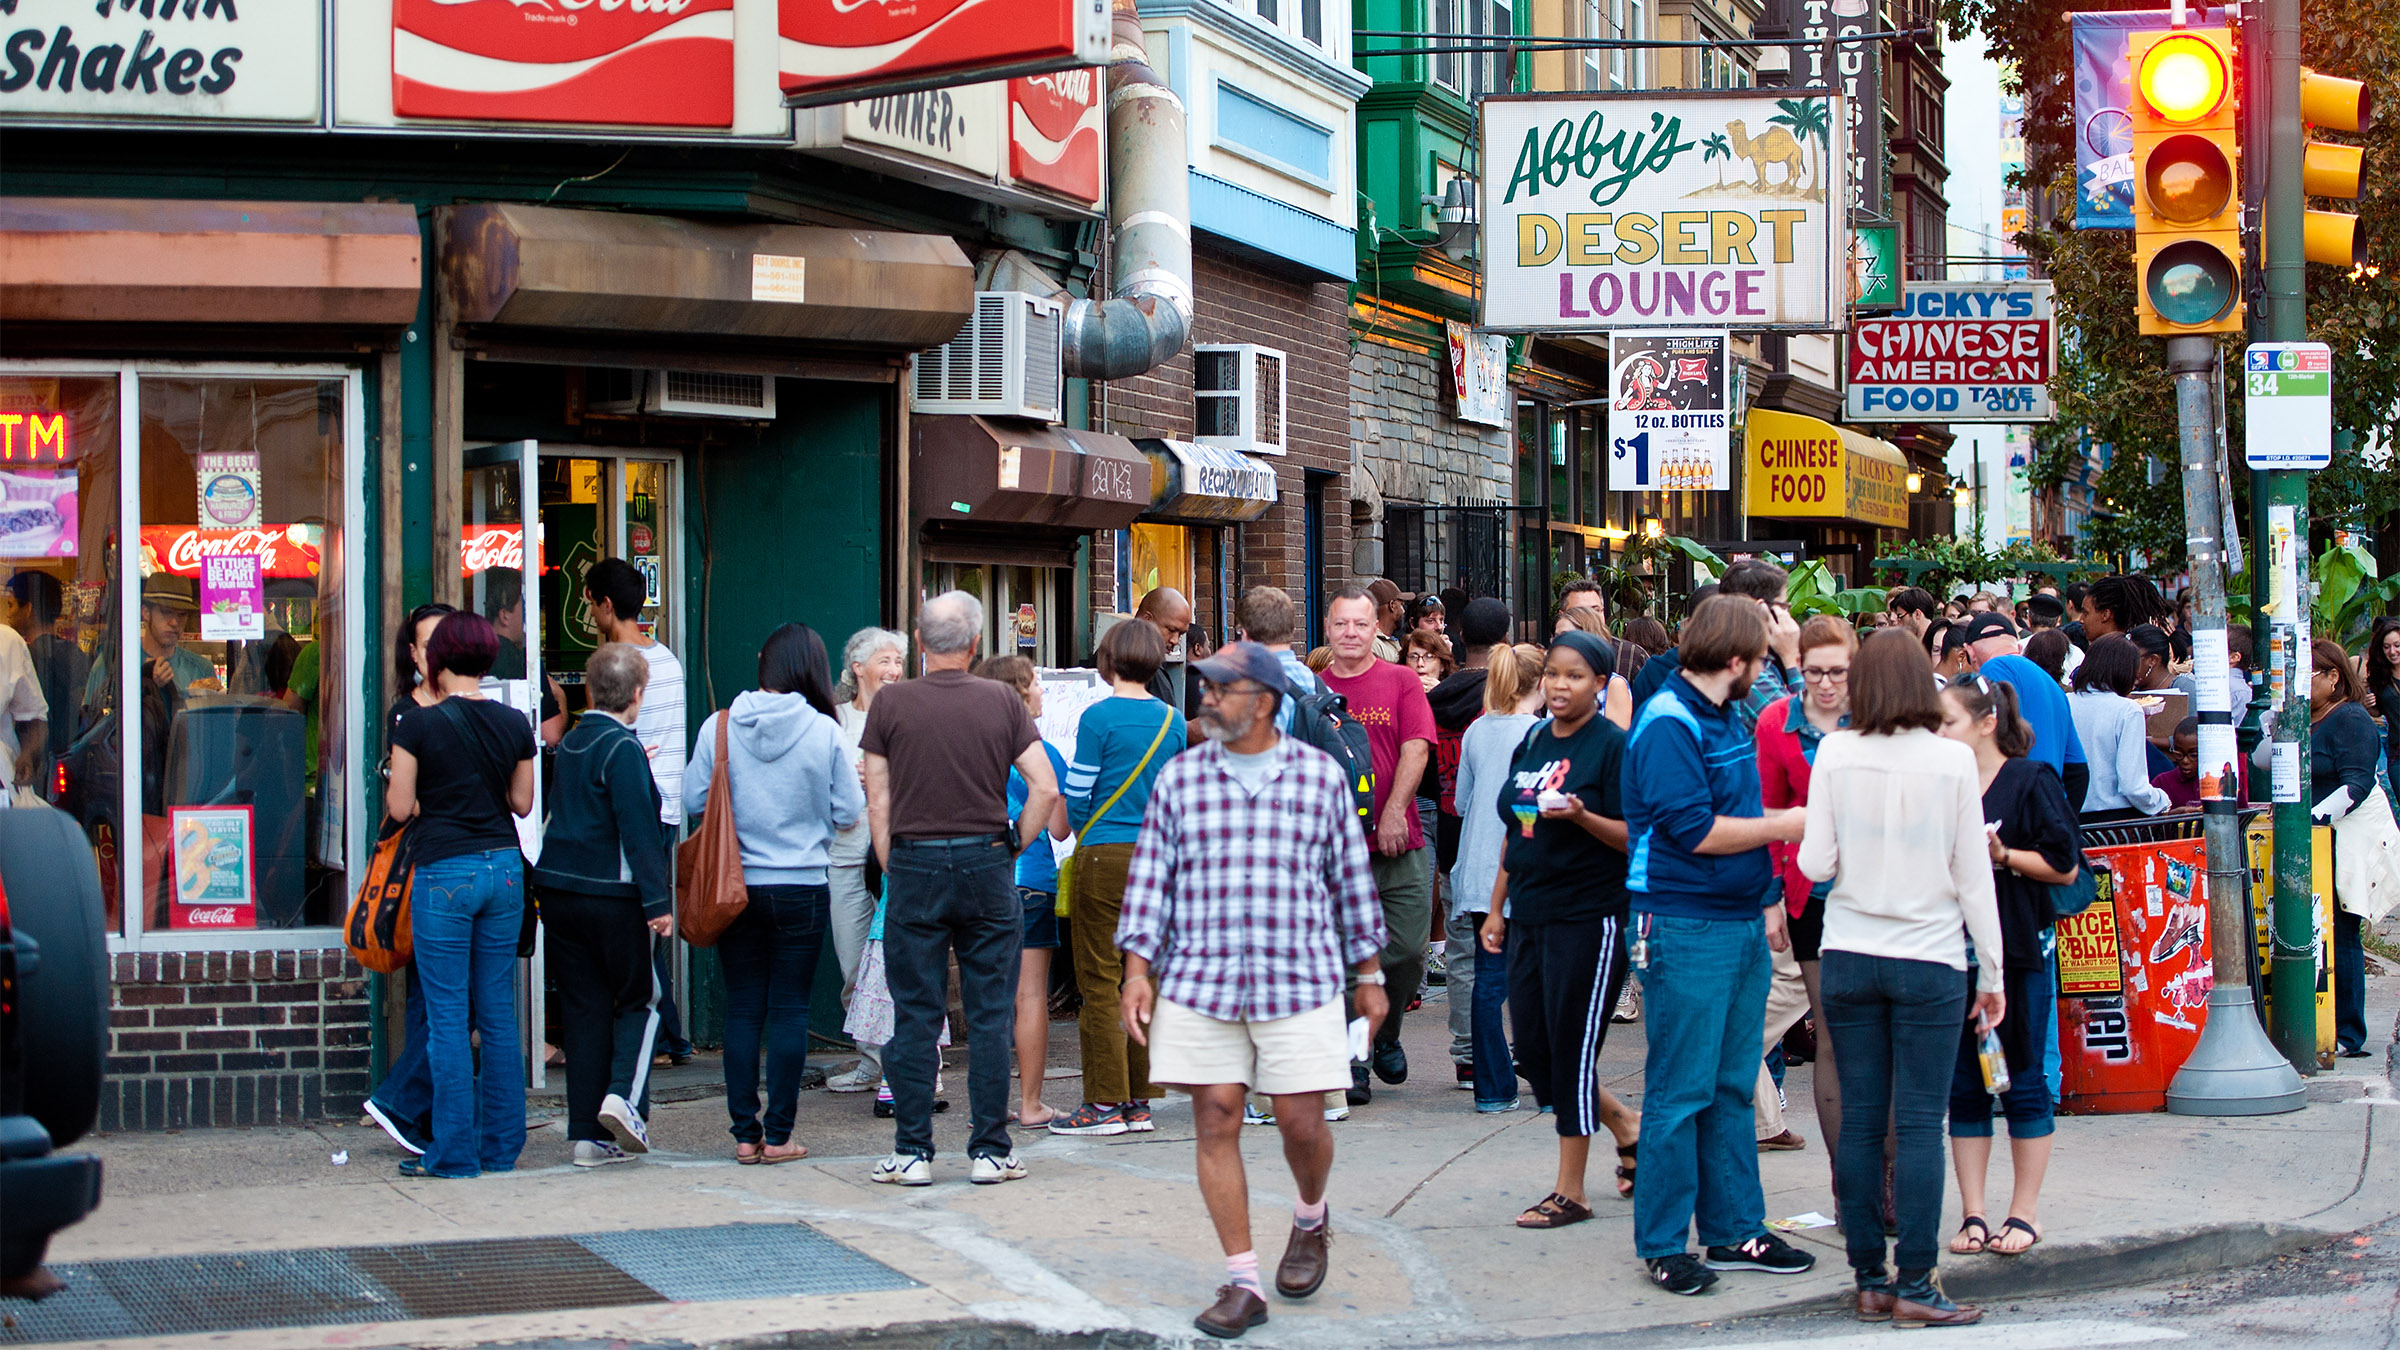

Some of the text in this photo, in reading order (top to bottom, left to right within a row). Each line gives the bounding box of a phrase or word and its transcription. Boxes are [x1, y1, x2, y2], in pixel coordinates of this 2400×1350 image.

[0, 25, 243, 95] Shakes
[1503, 110, 1697, 207] Abby's
[1517, 209, 1807, 267] DESERT
[1559, 270, 1766, 318] LOUNGE
[1892, 292, 2034, 318] UCKY'S
[1672, 339, 1714, 348] HIGH LIFE
[1857, 322, 2041, 359] CHINESE
[1855, 360, 2040, 381] AMERICAN
[1968, 387, 2033, 403] TAKE
[2250, 373, 2279, 396] 34
[1863, 387, 1960, 412] FOOD
[1987, 398, 2037, 412] OUT
[1635, 414, 1724, 428] 12 oz. BOTTLES
[203, 455, 255, 468] THE BEST
[1614, 432, 1649, 486] $1
[1761, 439, 1838, 468] CHINESE
[1771, 474, 1826, 503] FOOD
[207, 558, 256, 569] LETTUCE
[207, 581, 256, 589] OF YOUR MEAL
[208, 570, 256, 581] BE PART
[188, 907, 237, 924] Coca-Cola
[2058, 911, 2115, 937] NYCE
[2070, 959, 2098, 967] WALNUT
[2099, 958, 2118, 966] ROOM
